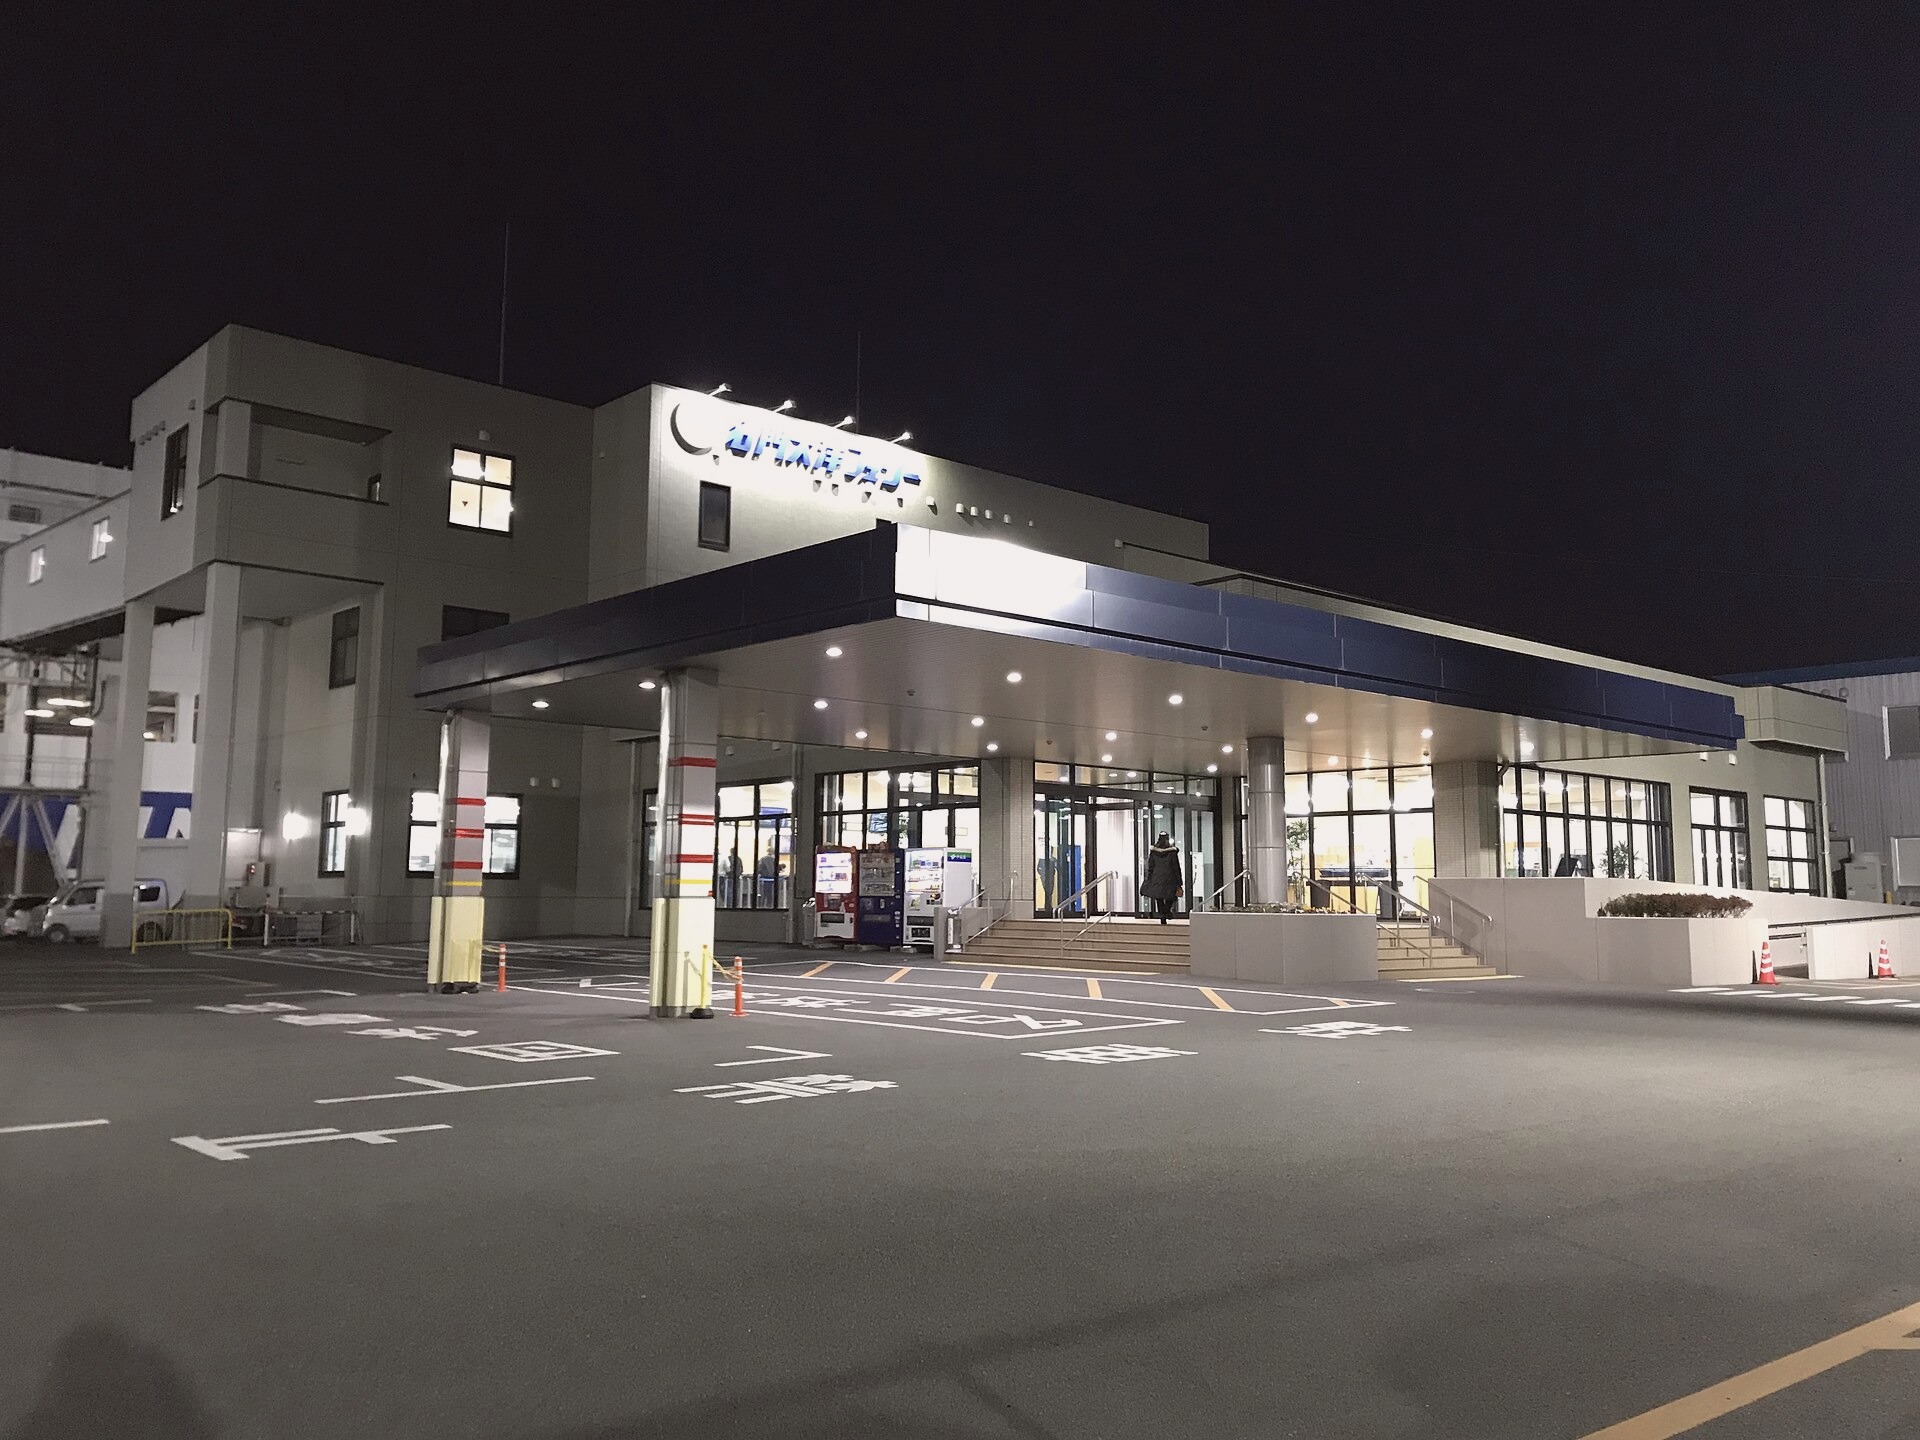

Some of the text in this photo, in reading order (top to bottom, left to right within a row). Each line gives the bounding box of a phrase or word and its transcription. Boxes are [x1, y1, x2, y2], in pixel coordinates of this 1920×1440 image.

[537, 978, 1085, 1030] 名門送迎ス
